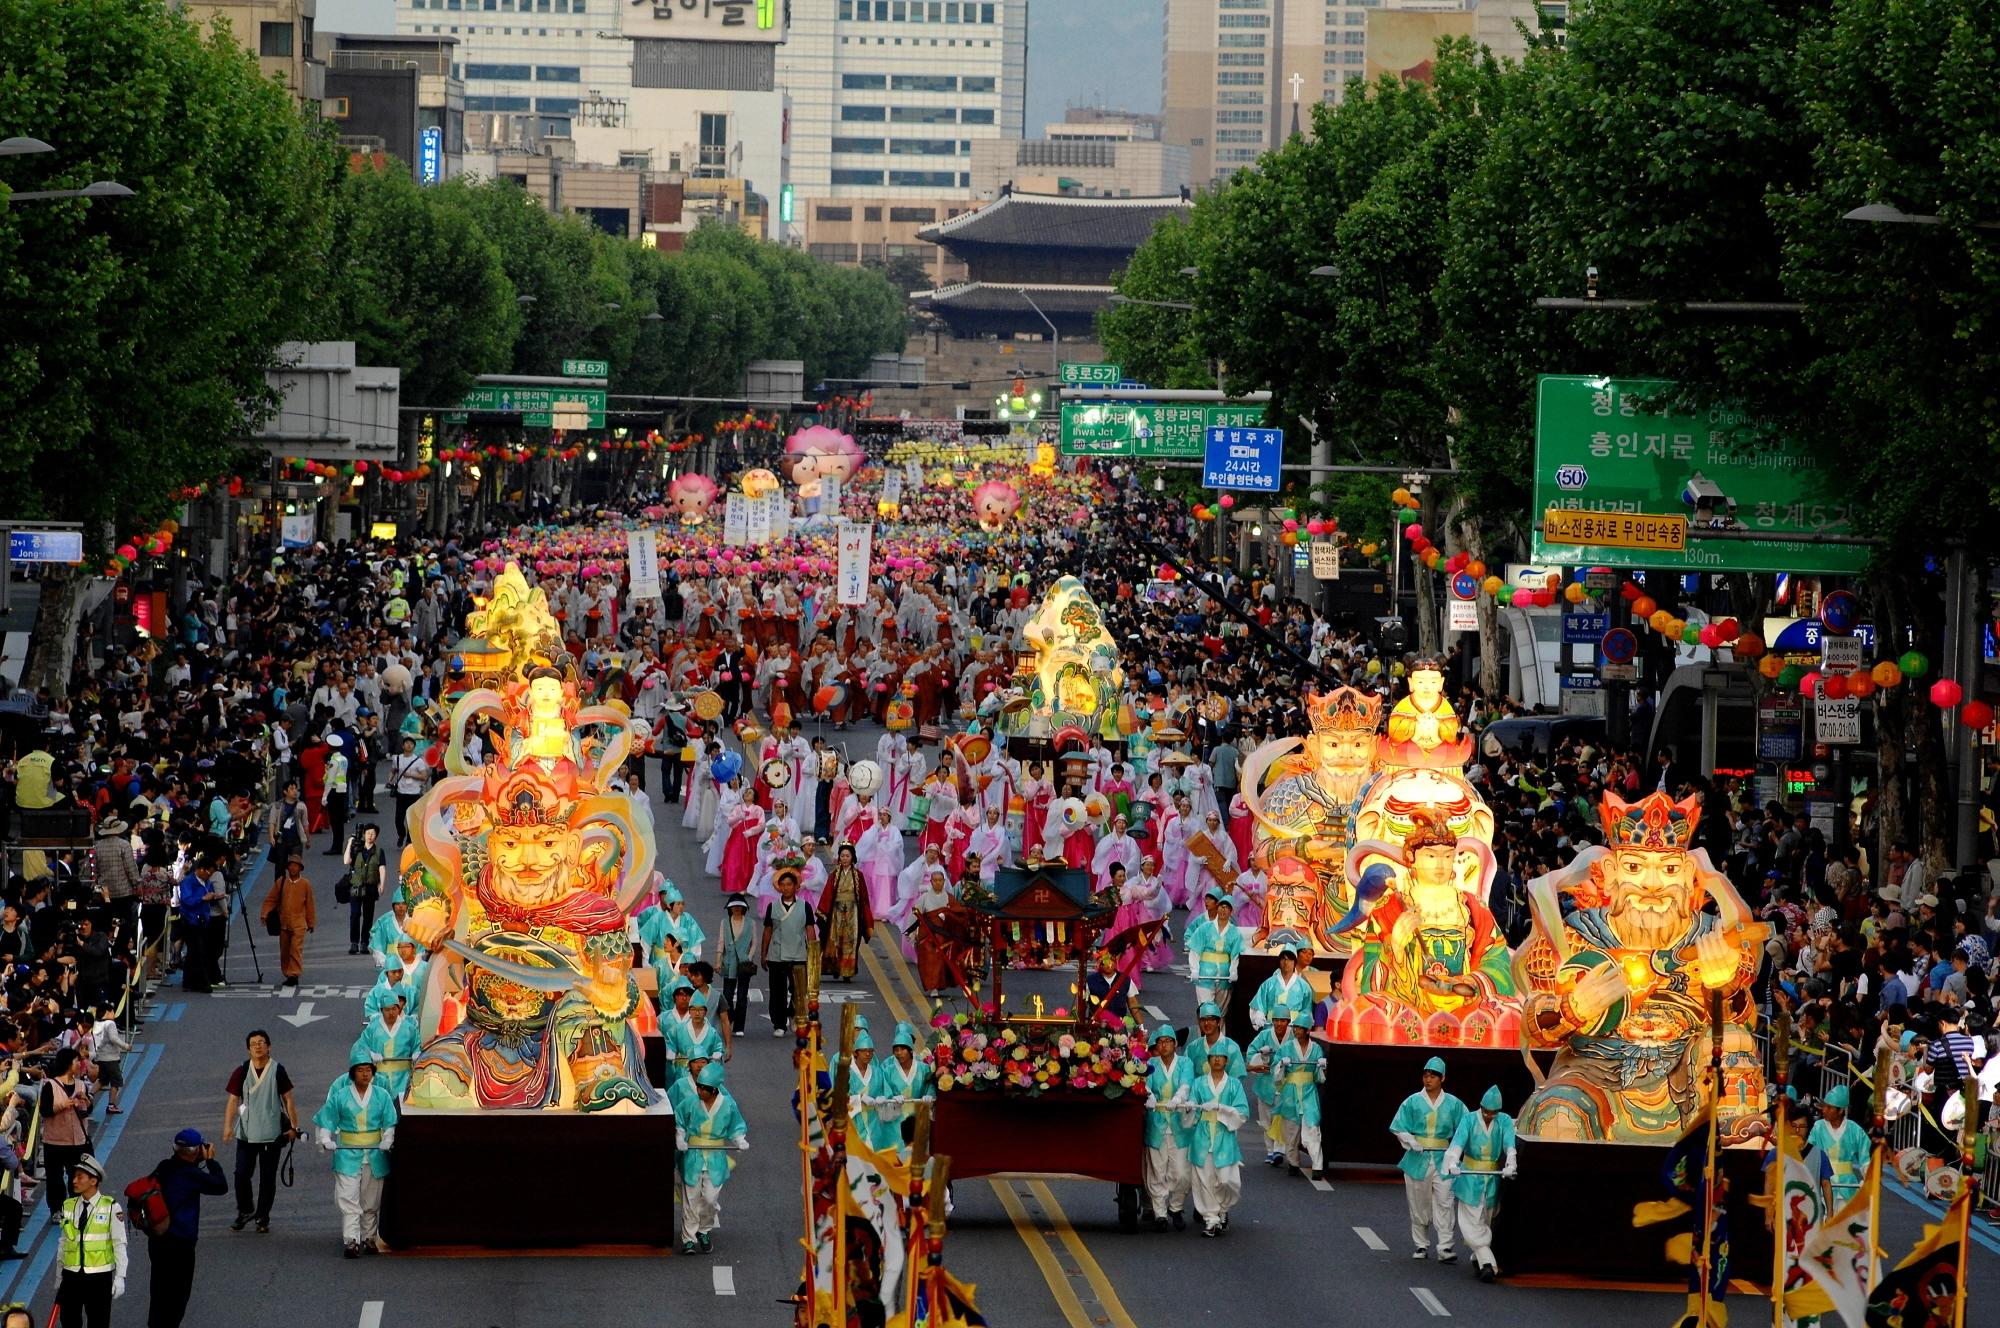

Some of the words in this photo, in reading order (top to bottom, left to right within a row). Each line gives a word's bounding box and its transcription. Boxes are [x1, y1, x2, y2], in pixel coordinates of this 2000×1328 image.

[566, 361, 604, 374] 종로5가
[1065, 366, 1117, 382] 종로5가
[1154, 409, 1203, 422] 청량리역
[1073, 428, 1095, 436] Ihwa
[1098, 428, 1113, 436] Jct
[1154, 424, 1202, 437] 흥인지문
[1589, 432, 1695, 459] 흥인지문
[1225, 460, 1261, 472] 24시간
[1562, 470, 1583, 485] 50
[1548, 517, 1618, 540] 버스전용차로
[1622, 520, 1681, 544] 무인단속중
[1684, 548, 1721, 564] 130m
[1818, 704, 1856, 719] 버스전용
[1819, 723, 1857, 738] 07:00-21:00
